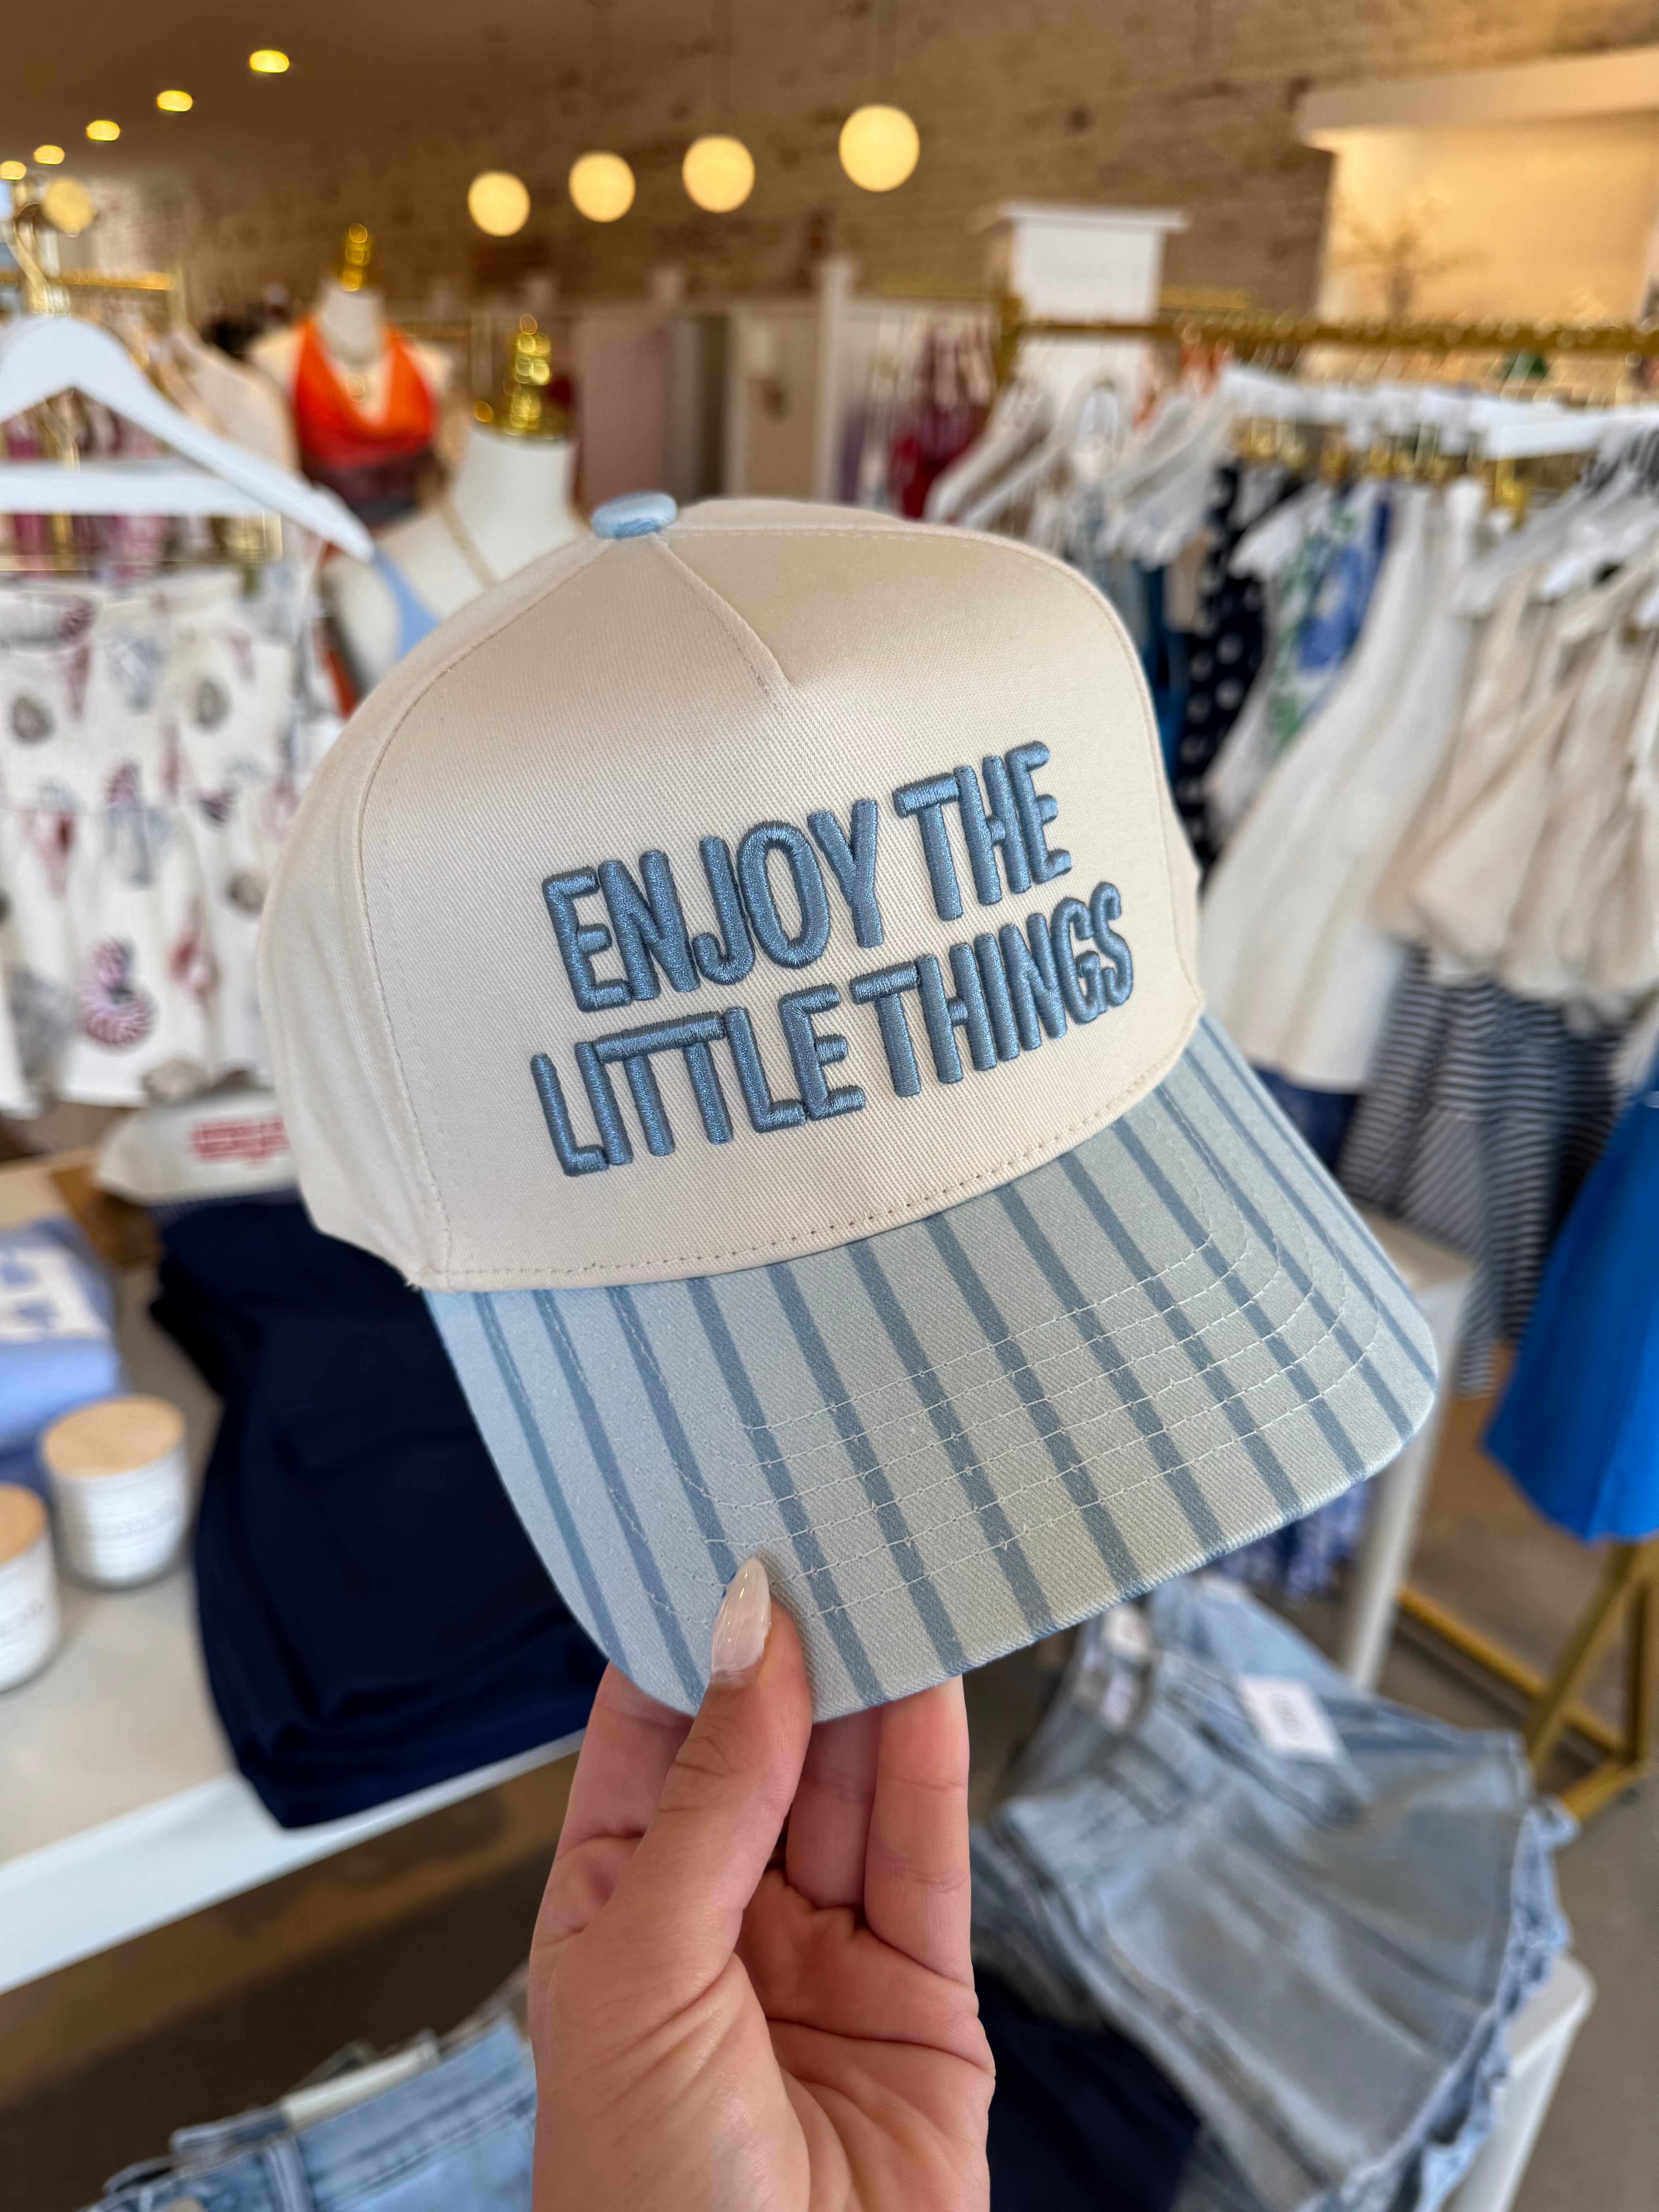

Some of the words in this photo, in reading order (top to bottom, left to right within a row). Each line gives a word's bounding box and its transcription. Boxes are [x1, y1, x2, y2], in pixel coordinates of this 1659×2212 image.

[543, 799, 884, 1012] ENJOY
[894, 740, 1072, 920] THE
[531, 984, 866, 1176] LITTLE
[850, 881, 1133, 1097] THINGS
